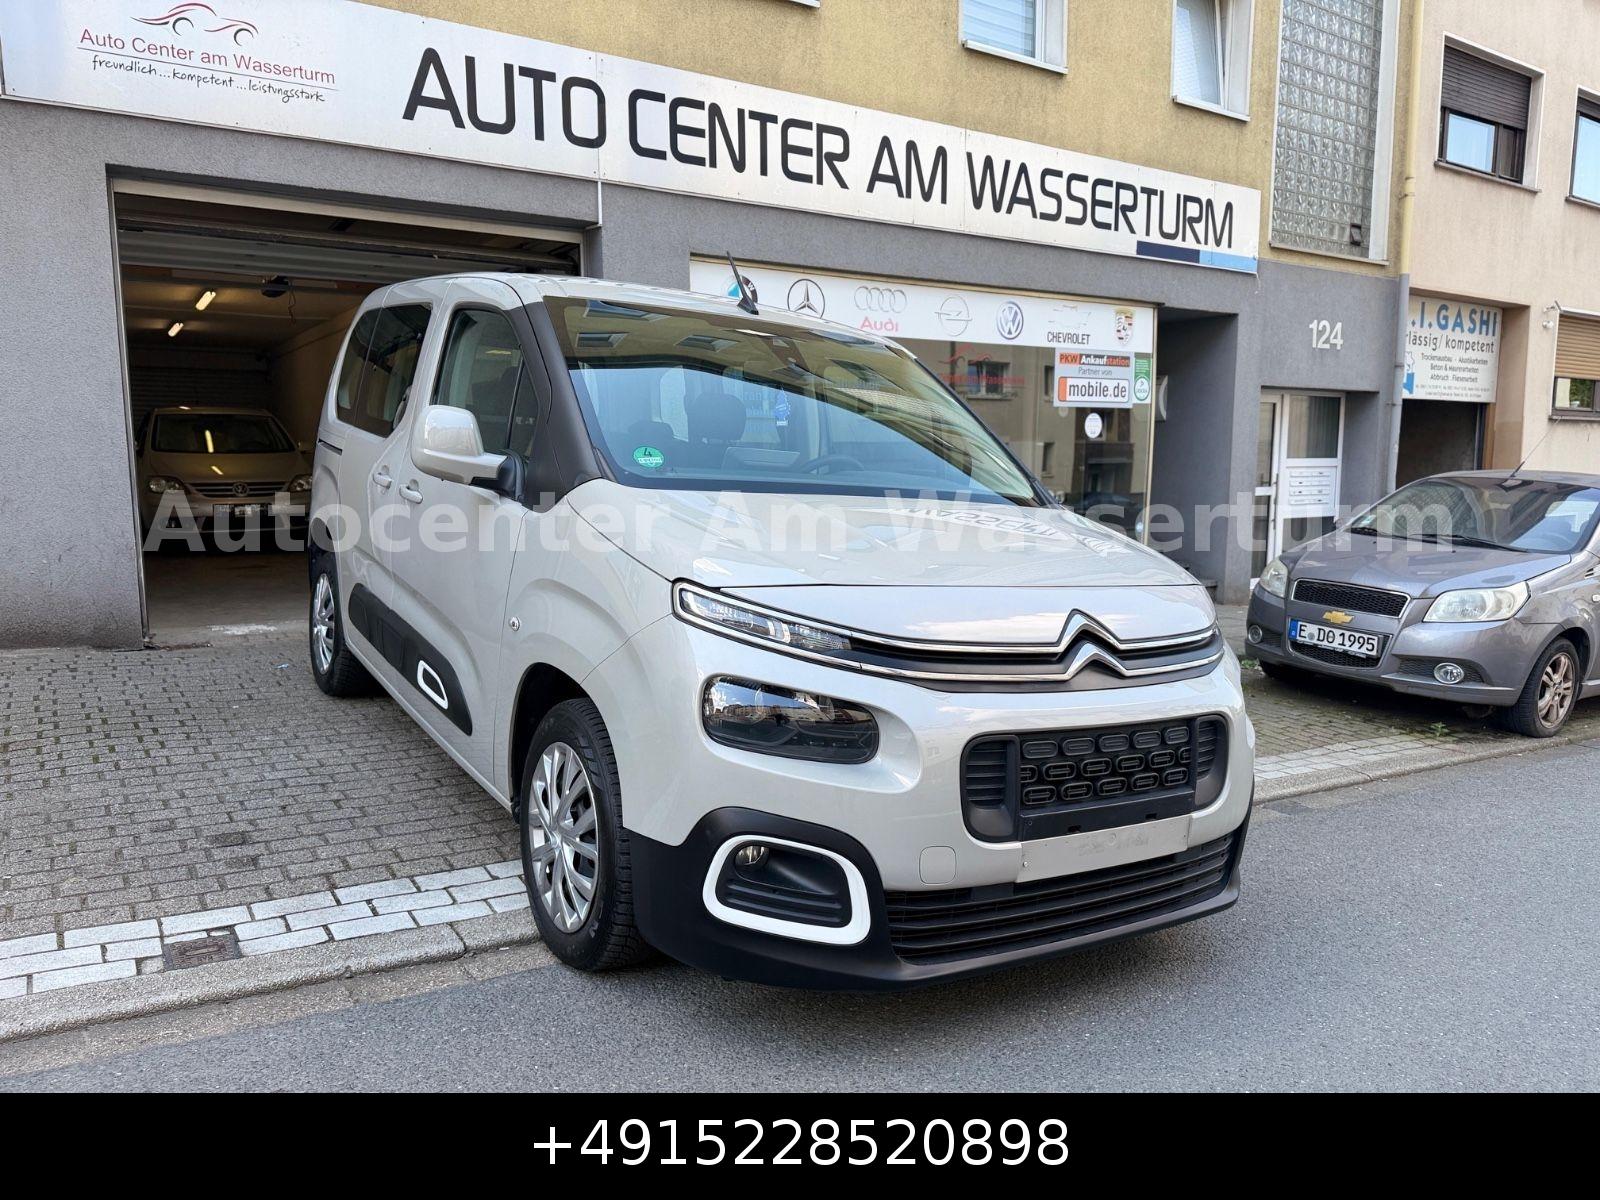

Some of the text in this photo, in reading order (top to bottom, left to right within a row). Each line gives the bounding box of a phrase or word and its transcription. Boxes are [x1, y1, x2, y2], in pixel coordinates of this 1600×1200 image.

[80, 28, 336, 85] Auto Center am Wasserturm
[402, 46, 1234, 250] AUTO CENTER AM WASSERTURM
[860, 316, 899, 332] Audi
[1046, 331, 1091, 345] CHEVROLET
[1309, 319, 1344, 350] 124
[1445, 335, 1495, 354] kompetent
[1060, 353, 1078, 365] PKW
[1078, 367, 1101, 376] Partner
[1068, 381, 1127, 398] mobile.de
[643, 447, 653, 458] 4
[1337, 632, 1376, 652] 1995
